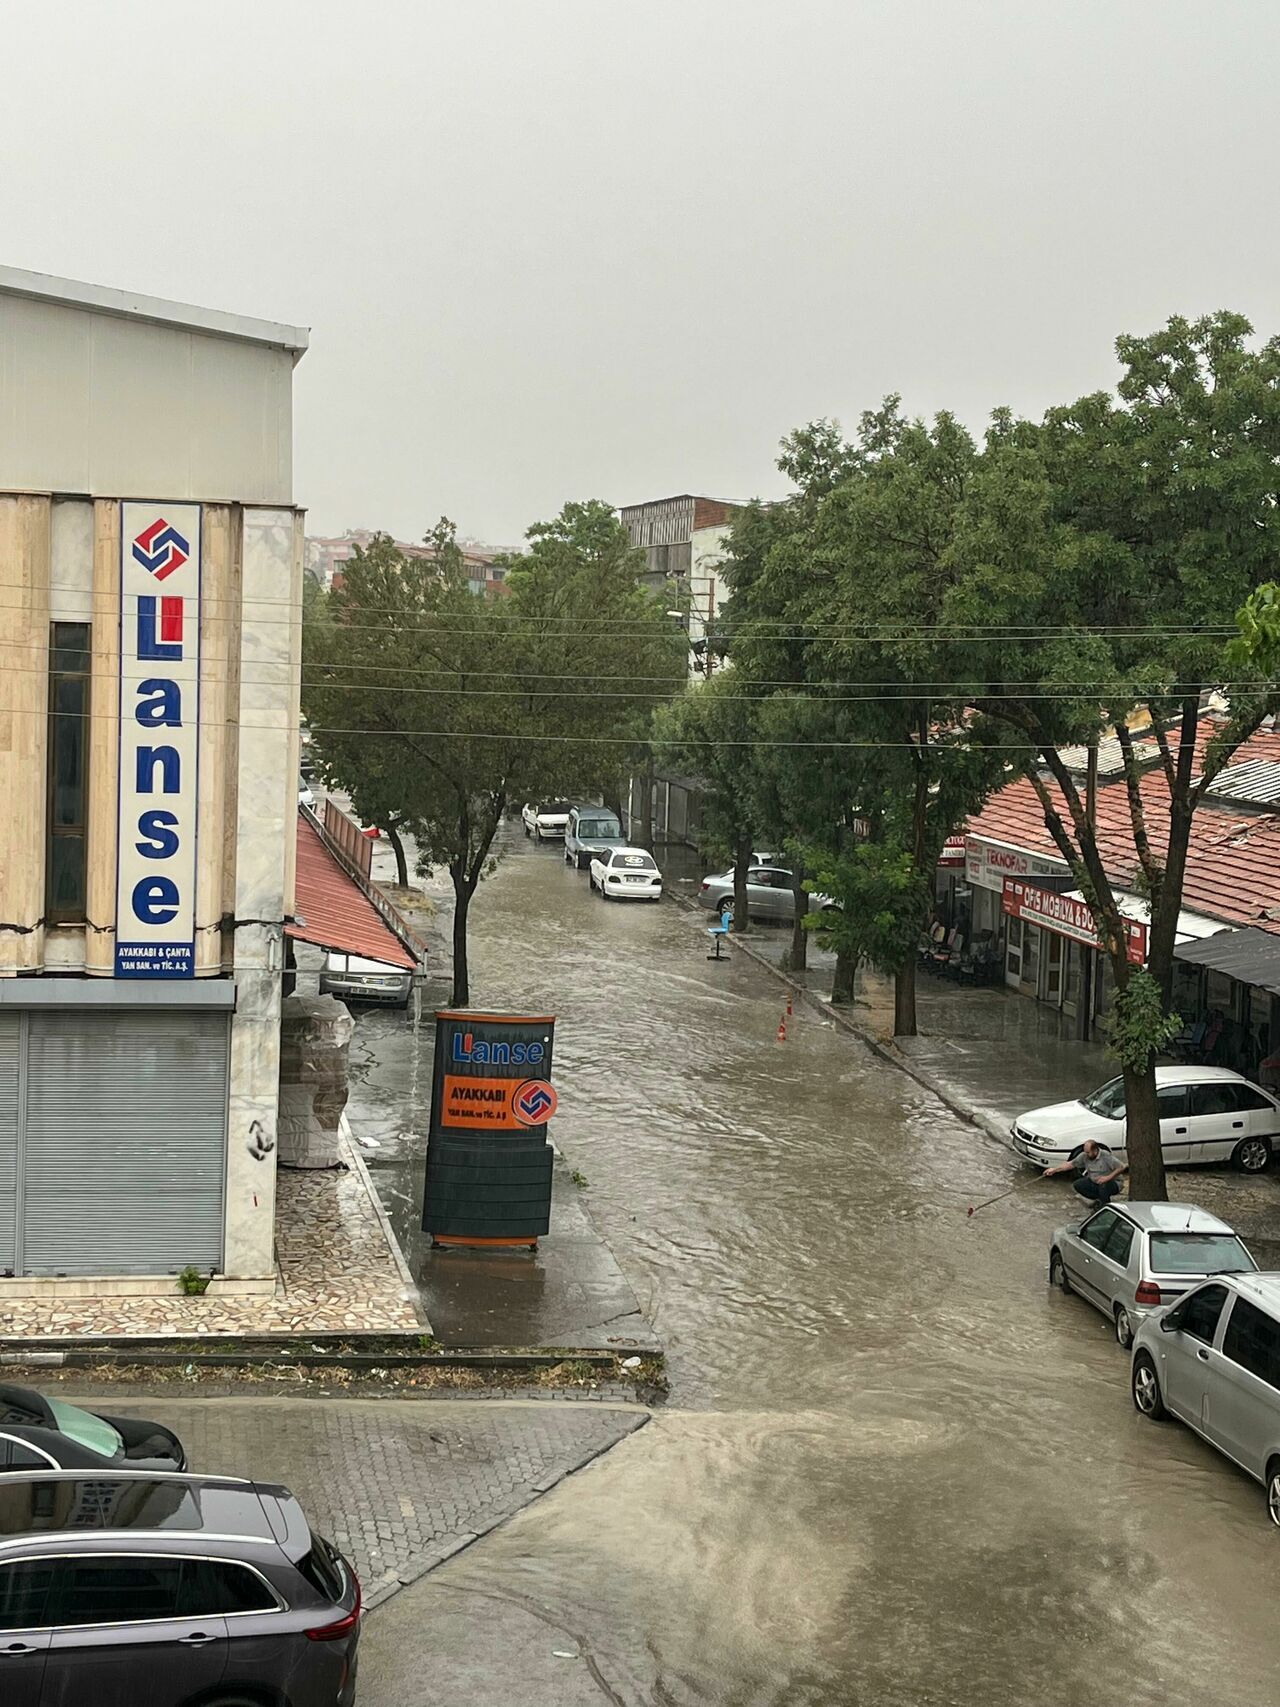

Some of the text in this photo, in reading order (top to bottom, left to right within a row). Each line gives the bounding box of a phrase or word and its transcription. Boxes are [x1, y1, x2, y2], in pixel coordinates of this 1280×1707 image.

[131, 595, 184, 926] Lanse
[1075, 905, 1081, 927] &
[118, 947, 191, 959] AYAKKABI & ÇANTA
[121, 961, 135, 970] YAN
[136, 961, 152, 970] SAN.
[452, 1032, 545, 1065] Lanse
[451, 1087, 506, 1102] AYAKKABI
